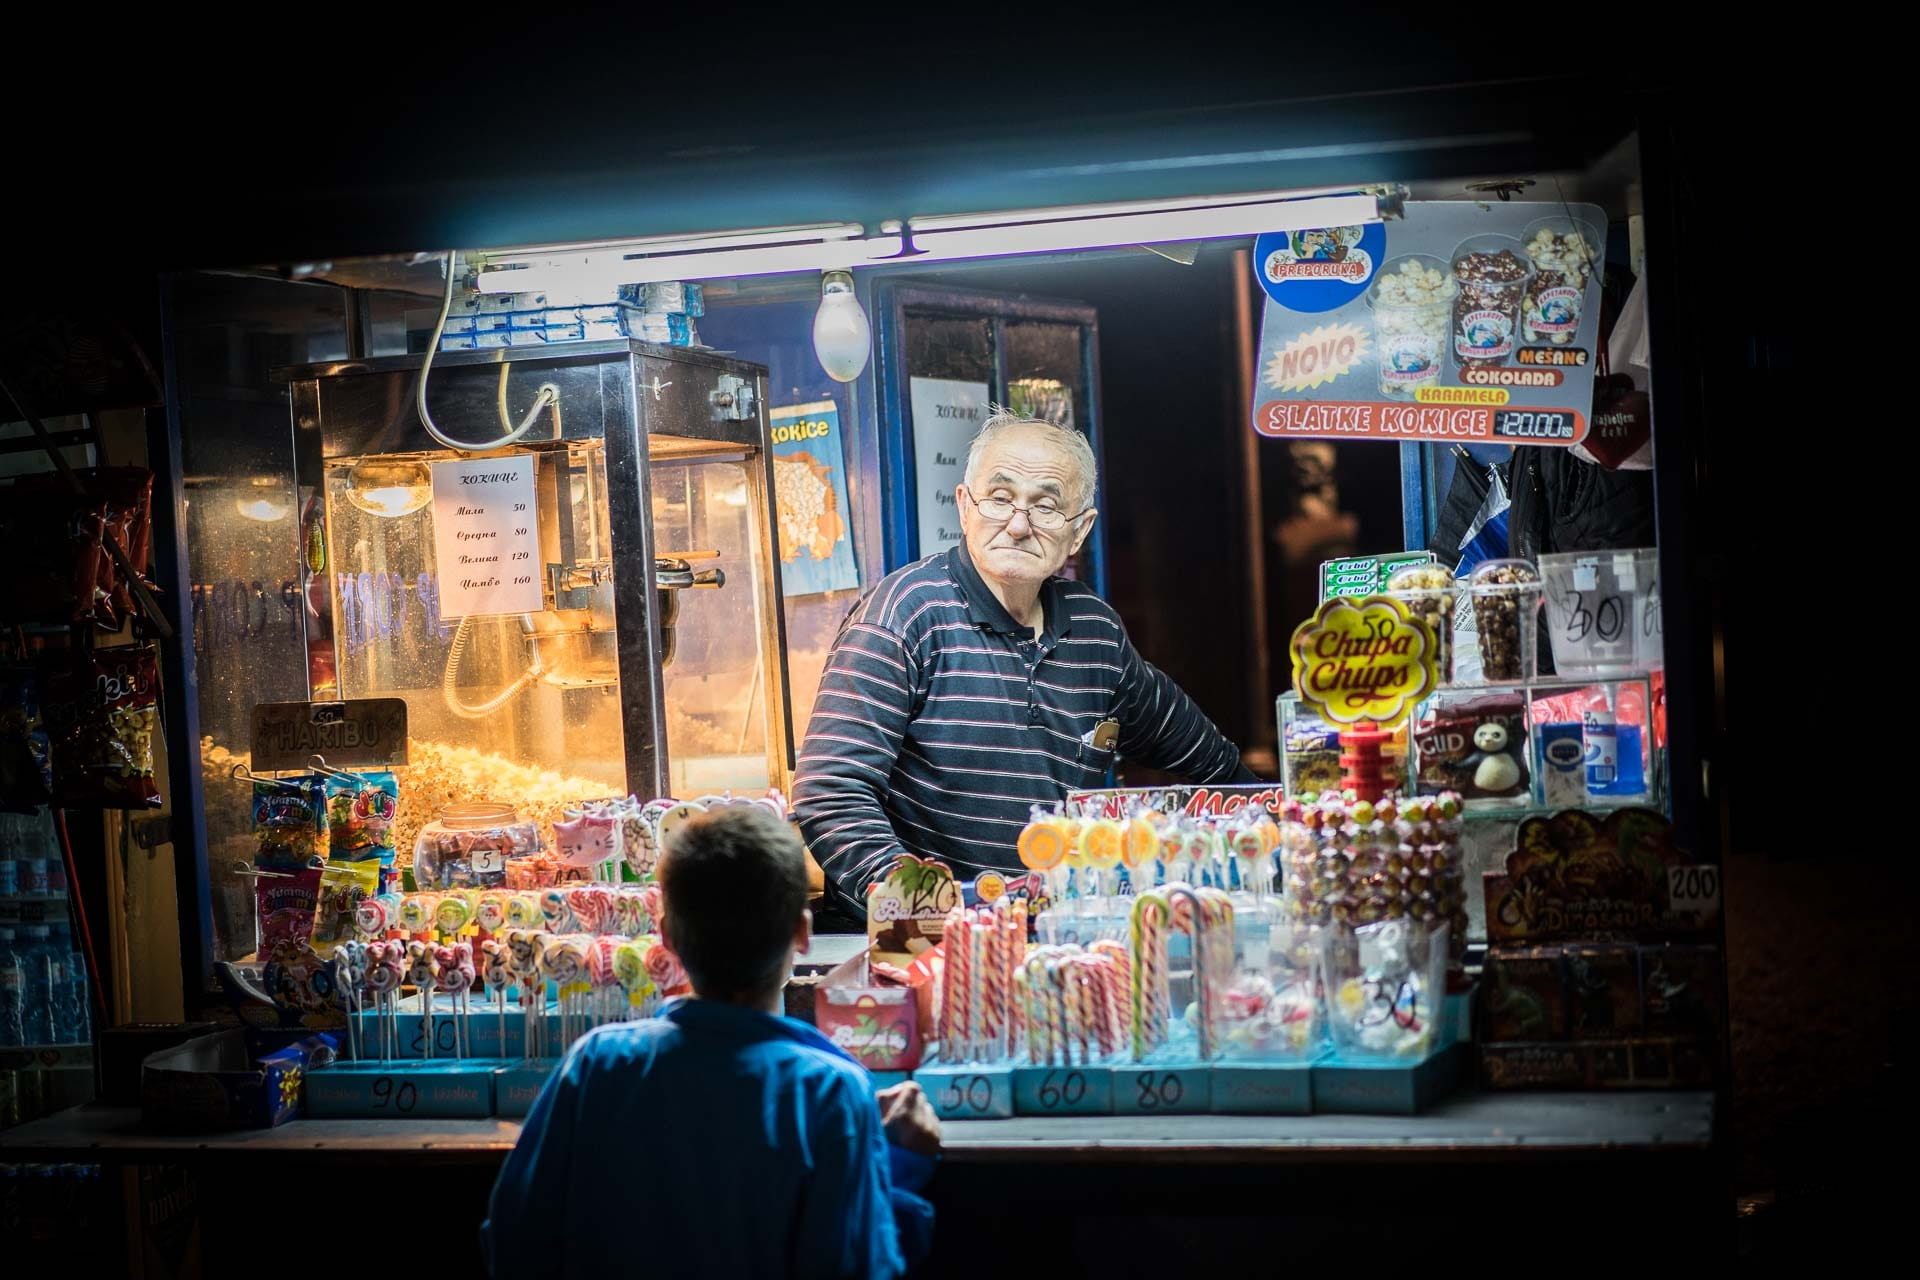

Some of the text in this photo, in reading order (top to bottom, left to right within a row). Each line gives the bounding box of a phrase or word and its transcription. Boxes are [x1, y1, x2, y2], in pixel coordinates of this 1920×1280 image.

[1278, 263, 1357, 276] PREPORUKA
[1281, 336, 1356, 381] NOVO
[1519, 348, 1586, 365] MEŠANE
[1466, 367, 1556, 386] ČOKOLADA
[1420, 389, 1507, 403] KARAMELA
[1269, 405, 1373, 432] SLATKE
[1380, 408, 1488, 435] KOKICE
[459, 472, 519, 485] КОКИЦЕ
[456, 503, 526, 517] Мала 50
[514, 528, 527, 536] 80
[458, 552, 529, 565] Велика 120
[1337, 562, 1369, 573] Orbit
[513, 576, 531, 585] 160
[1337, 574, 1369, 585] Orbit
[1337, 586, 1369, 597] Orbit
[1363, 613, 1396, 639] 50
[1316, 630, 1412, 664] Chupa
[1311, 661, 1411, 705] Chups
[1184, 787, 1284, 819] Mars
[481, 851, 493, 869] 5
[1671, 869, 1717, 899] 200
[411, 1015, 456, 1051] 80
[373, 1076, 416, 1112] 90
[942, 1073, 992, 1112] 50
[1040, 1070, 1086, 1108] 60
[1137, 1071, 1182, 1109] 80
